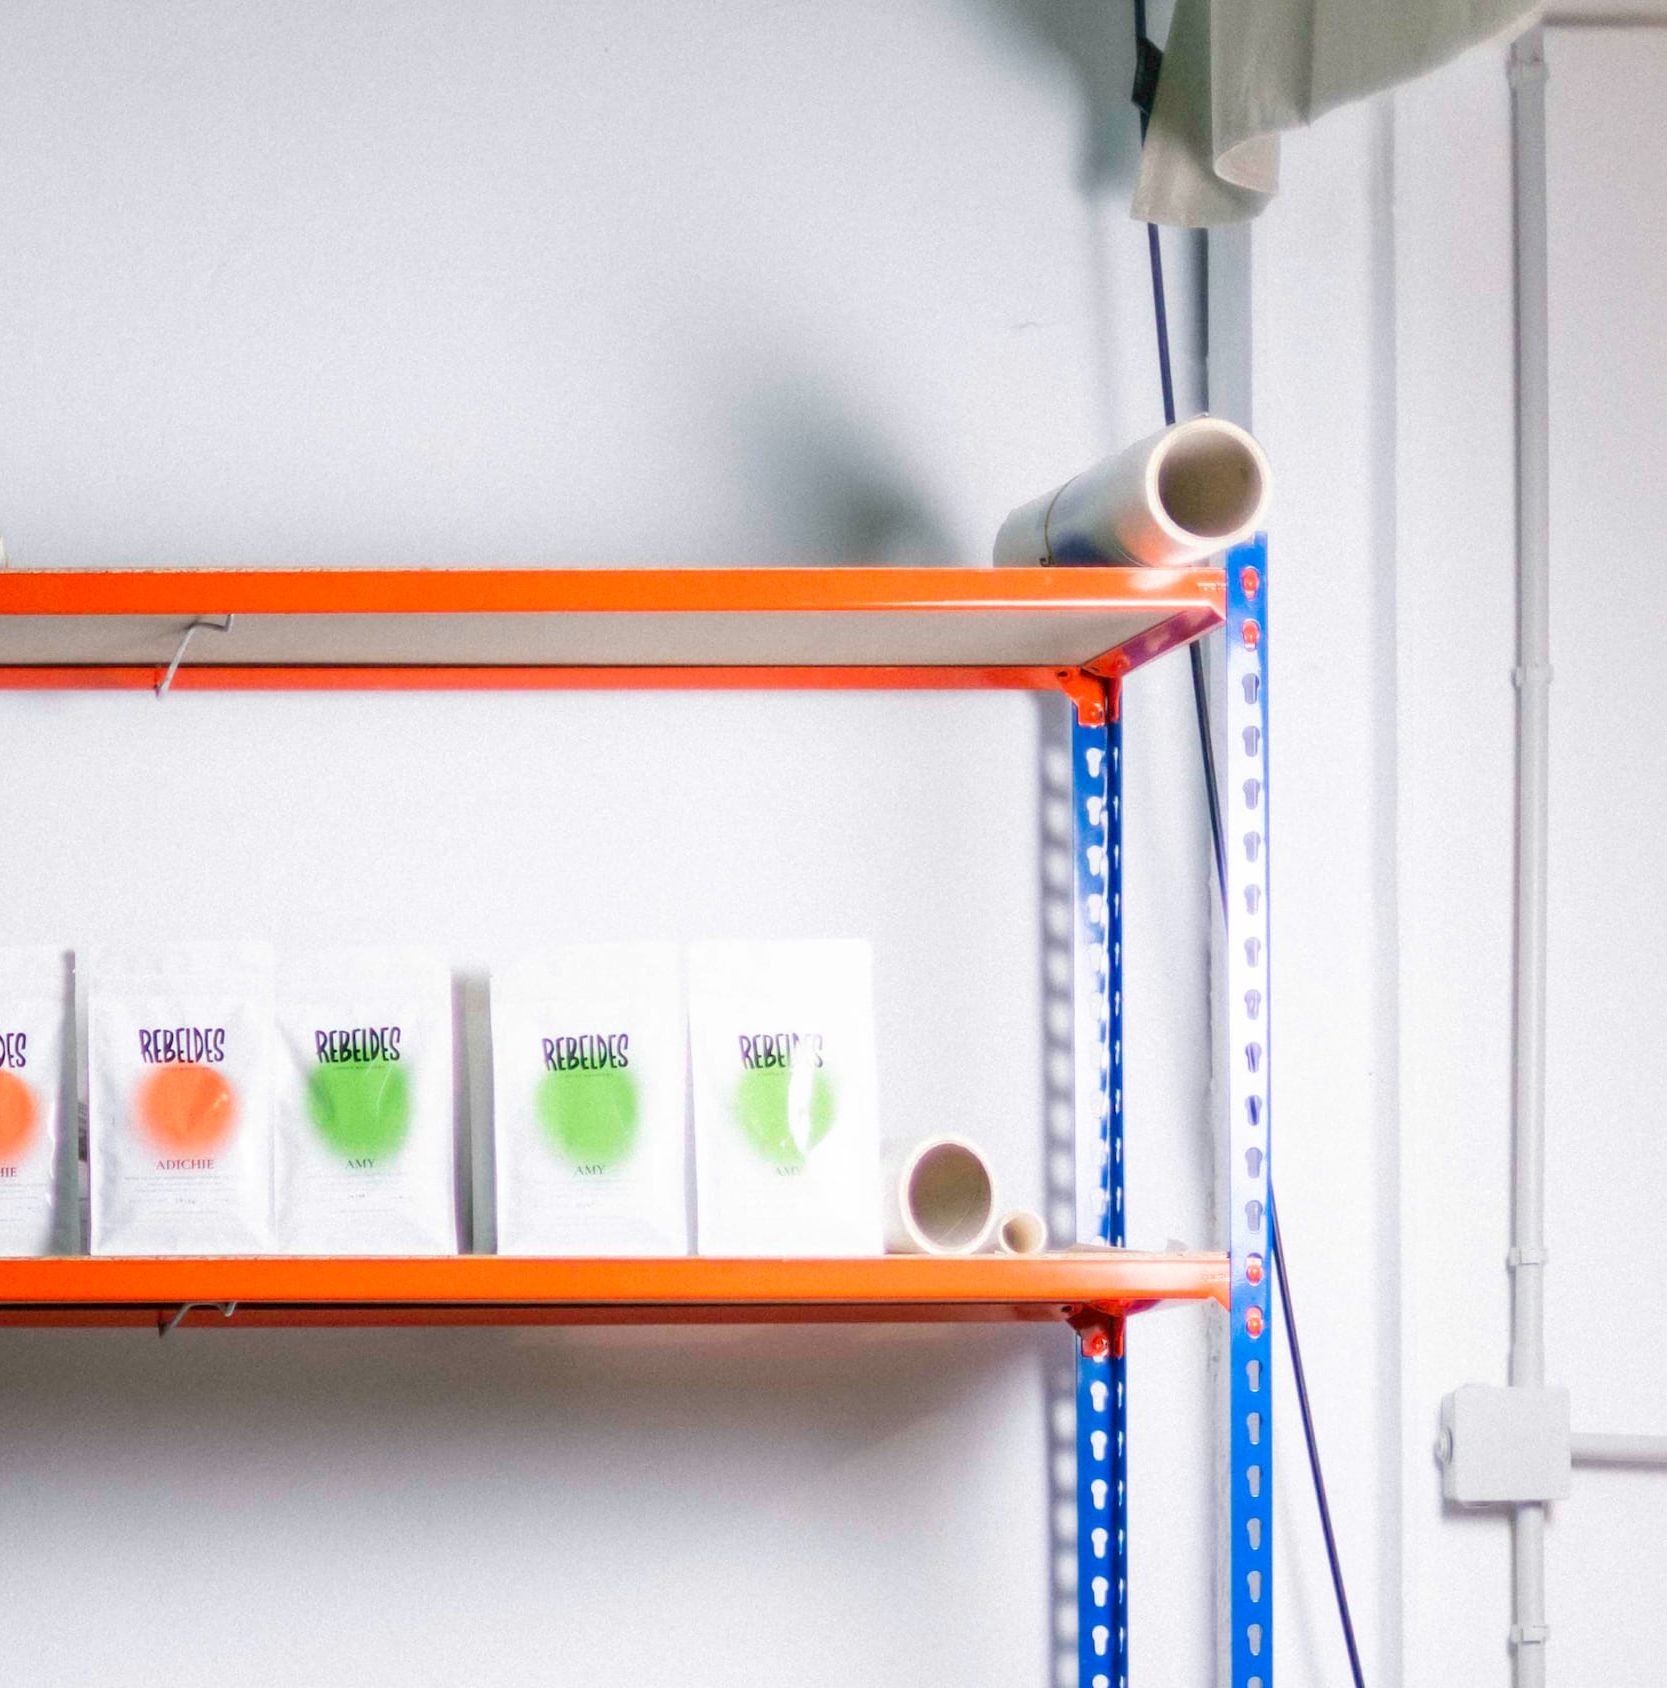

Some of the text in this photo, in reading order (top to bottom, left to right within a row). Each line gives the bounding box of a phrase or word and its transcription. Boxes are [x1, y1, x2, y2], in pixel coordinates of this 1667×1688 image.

[139, 1027, 225, 1064] REBELDES
[315, 1027, 401, 1063] REBELDES
[541, 1033, 629, 1071] REBELDES
[156, 1159, 214, 1170] ADICHIE
[345, 1159, 375, 1169] AMY
[573, 1165, 604, 1175] AMY
